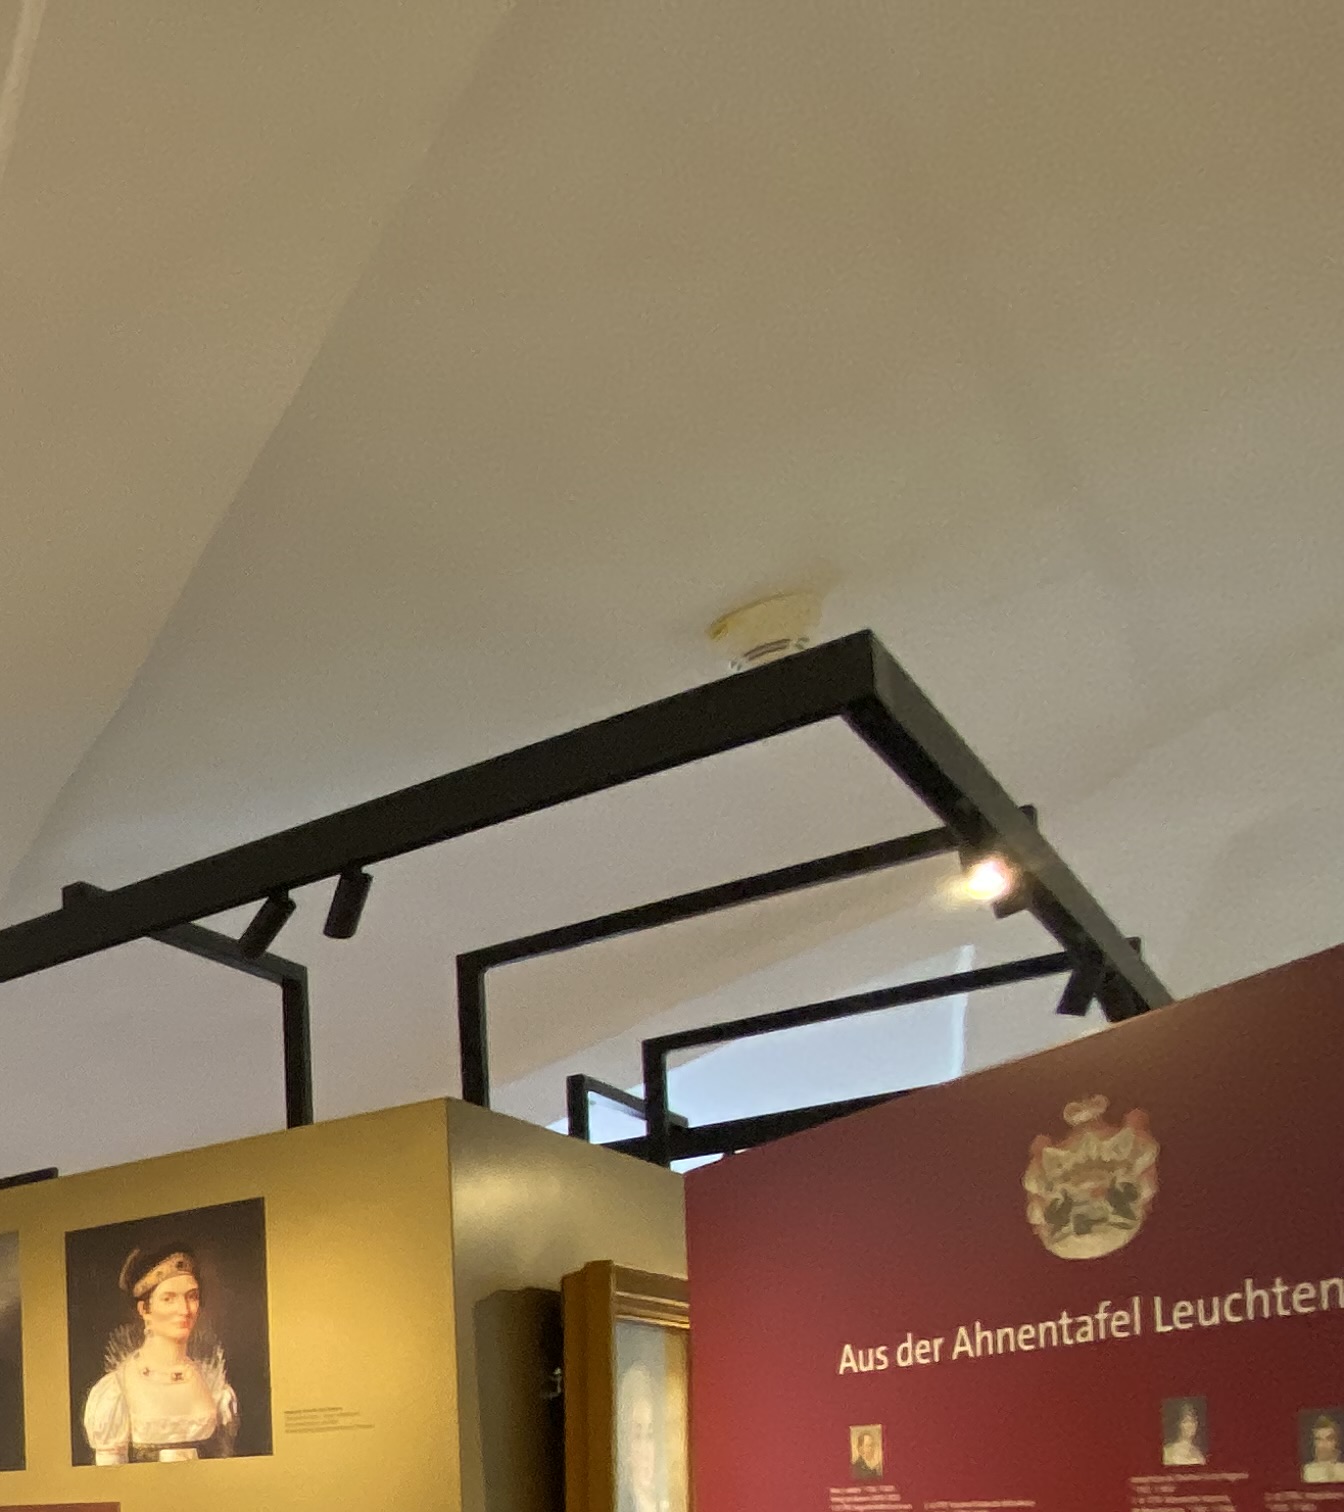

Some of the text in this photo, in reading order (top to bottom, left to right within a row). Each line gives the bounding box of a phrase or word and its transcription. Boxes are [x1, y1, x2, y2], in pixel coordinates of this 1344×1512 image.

[837, 1342, 889, 1375] Aus
[896, 1332, 946, 1367] der
[951, 1295, 1142, 1361] Ahnentafel
